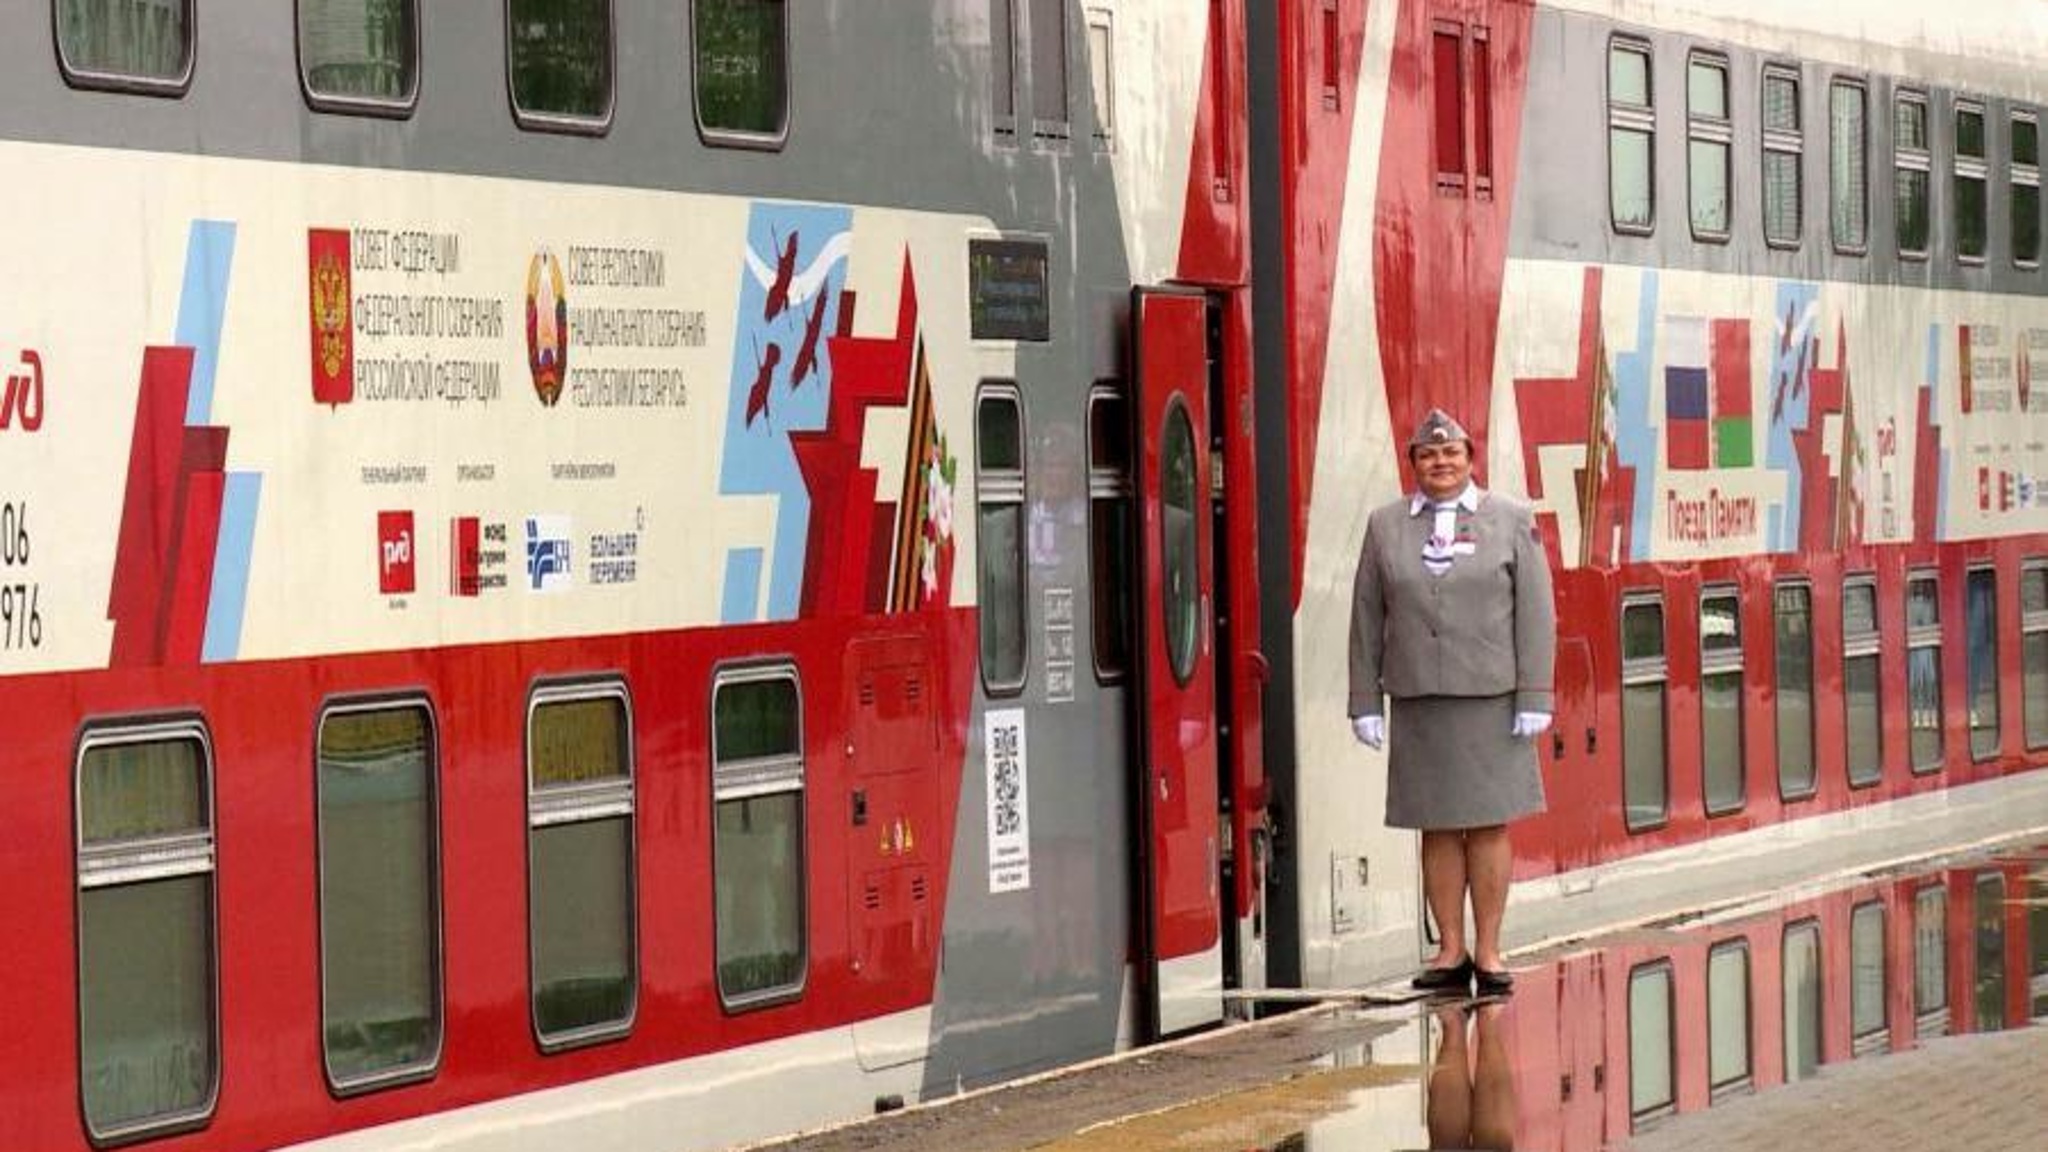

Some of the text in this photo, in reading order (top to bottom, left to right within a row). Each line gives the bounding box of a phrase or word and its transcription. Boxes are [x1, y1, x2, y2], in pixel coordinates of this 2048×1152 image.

[354, 229, 460, 281] СОВЕТ ФЕДЕРАЦИИ
[601, 248, 665, 288] РЕСПУБЛИКИ
[355, 294, 503, 343] ФЕДЕРАЛЬНОГО СОБРАНИЯ
[571, 308, 706, 355] НАЦИОНАЛЬНОГО СОБРАНИЯ
[357, 351, 500, 409] РОССИЙСКОЙ ФЕДЕРАЦИИ
[572, 368, 687, 408] РЕСПУБЛИКИ БЕЛАРУСЬ
[1668, 488, 1756, 547] Поезд Памяти
[1, 584, 42, 650] 976
